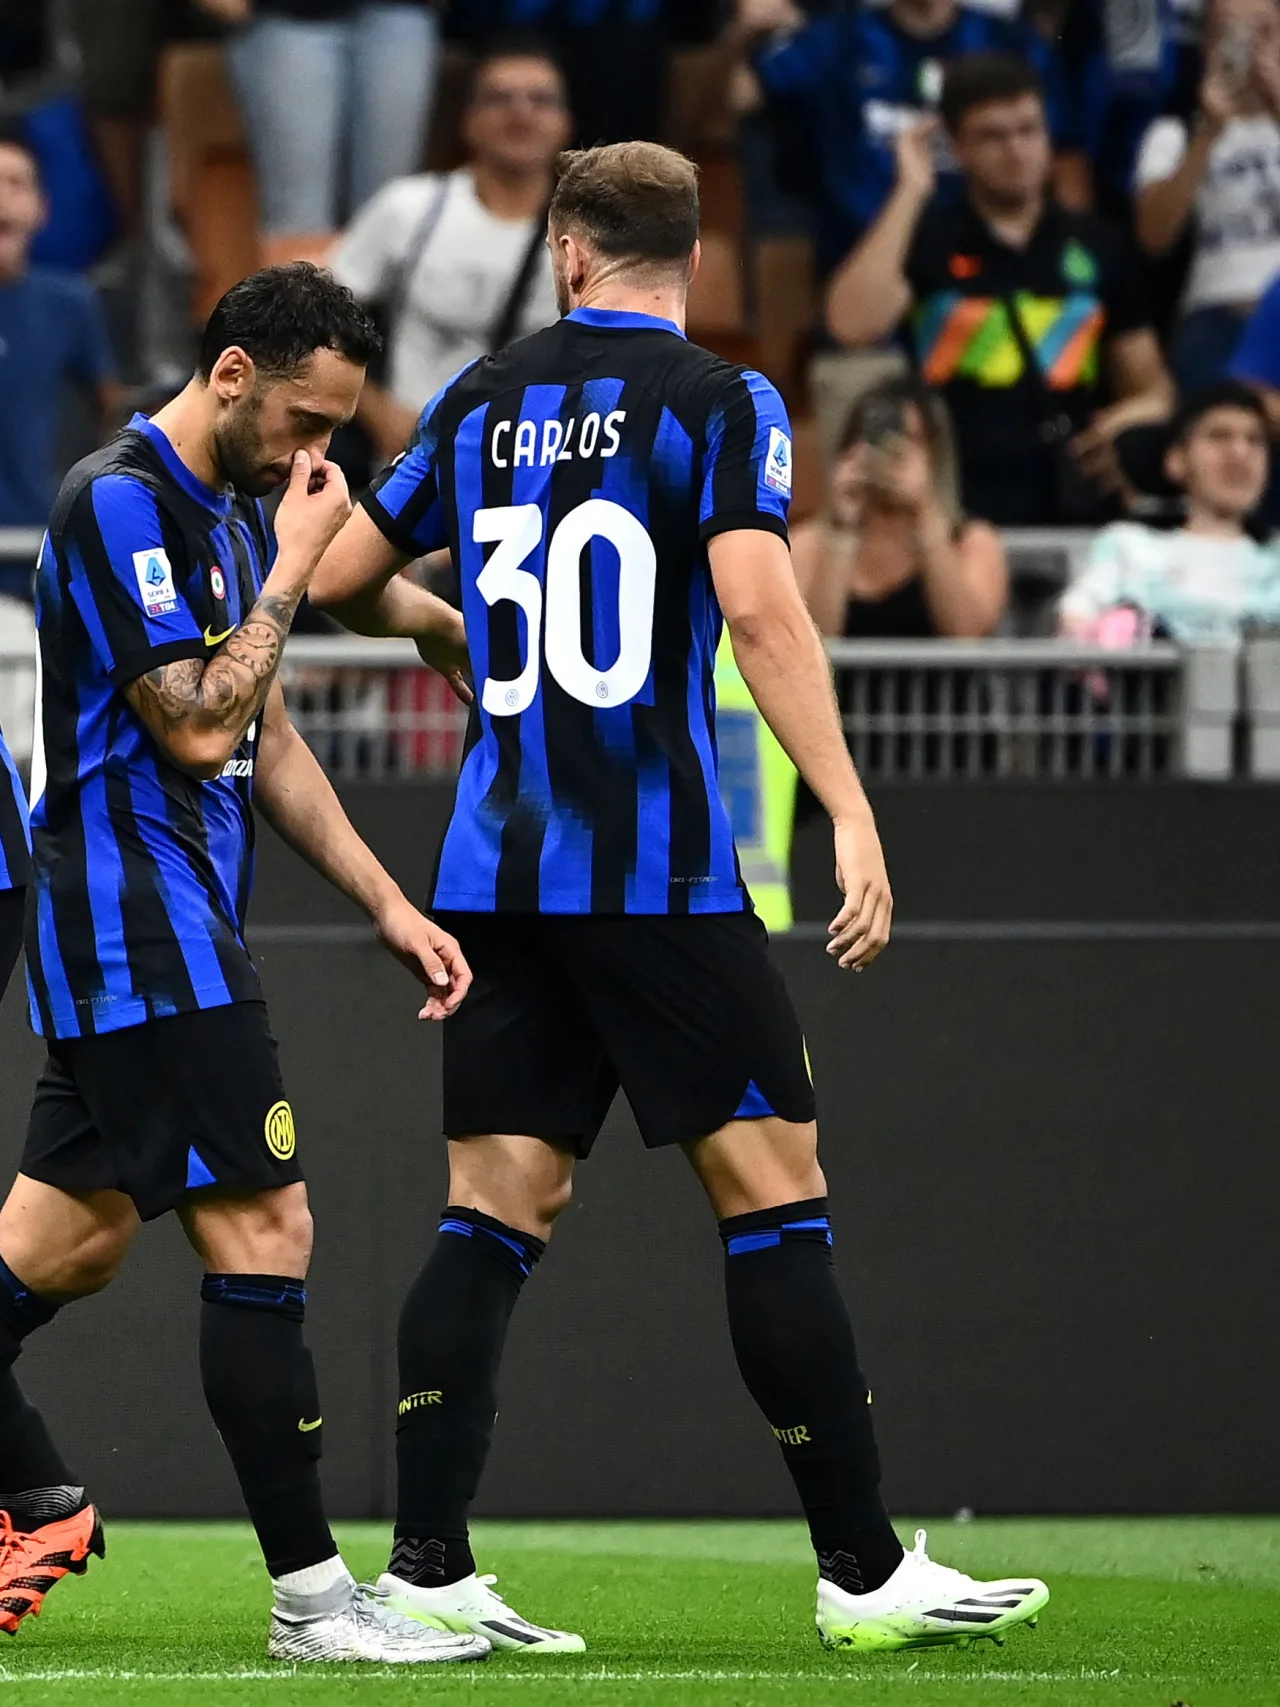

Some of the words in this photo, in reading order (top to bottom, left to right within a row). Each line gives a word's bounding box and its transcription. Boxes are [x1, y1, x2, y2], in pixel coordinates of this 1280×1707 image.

[491, 410, 626, 468] CARLOS
[473, 498, 657, 716] 30
[398, 1390, 443, 1416] INTER
[770, 1424, 812, 1445] NTER
